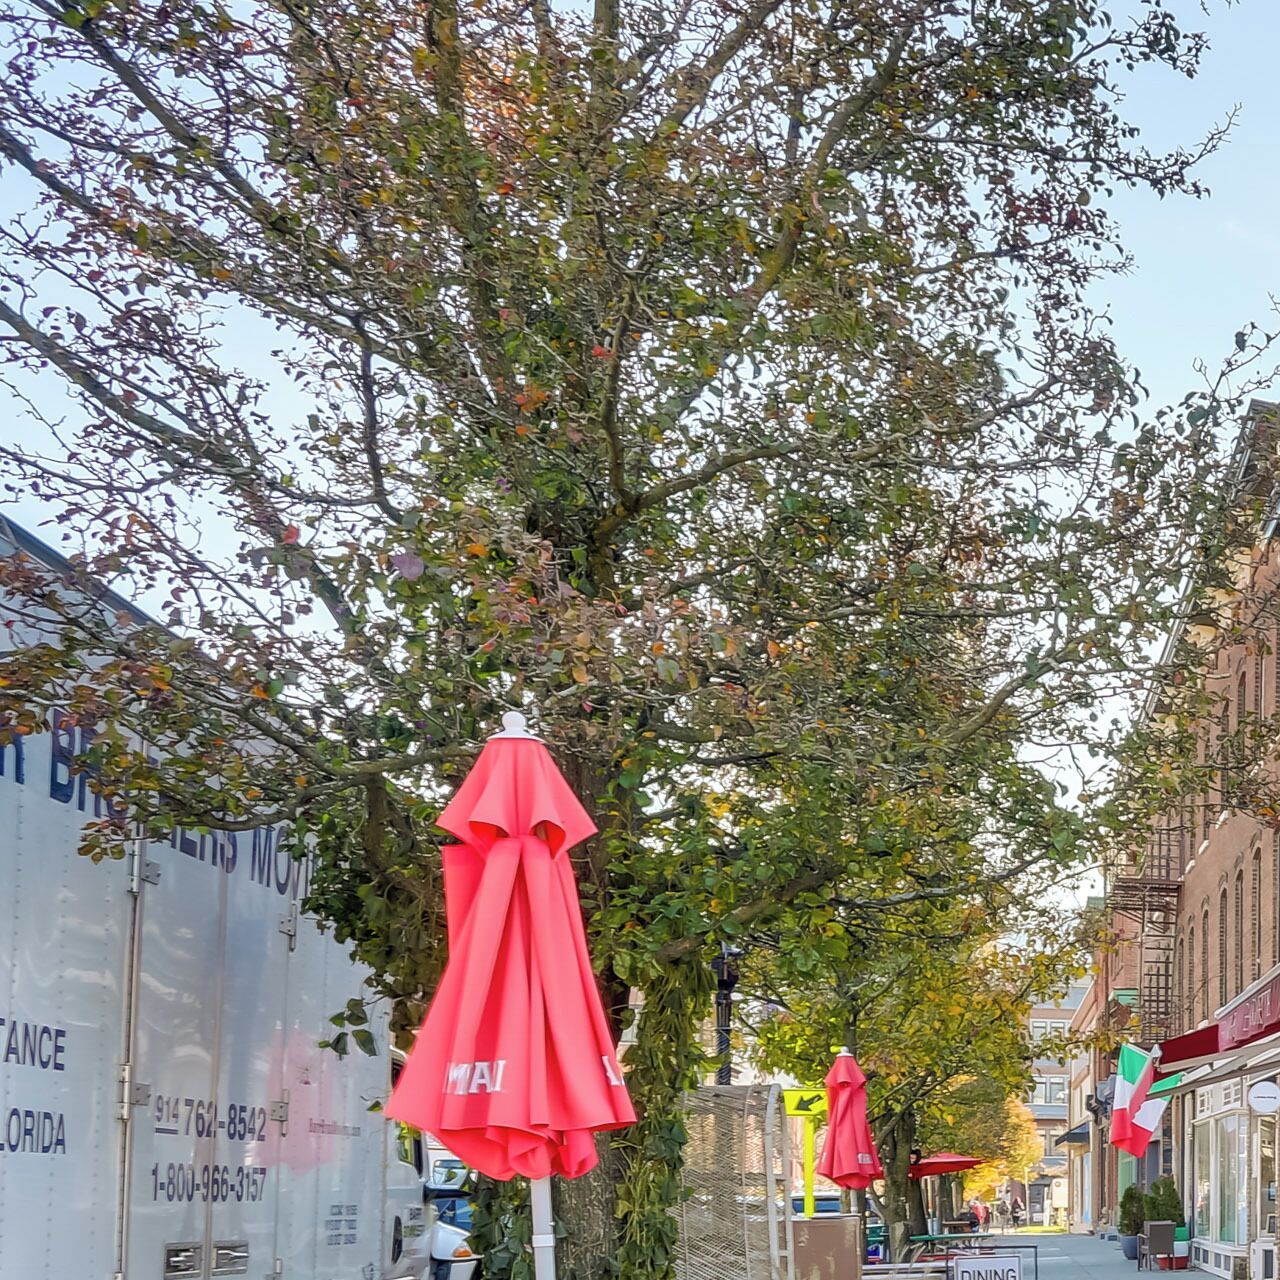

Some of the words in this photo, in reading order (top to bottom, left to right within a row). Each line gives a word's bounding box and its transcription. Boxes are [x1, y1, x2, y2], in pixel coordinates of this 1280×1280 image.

[0, 1018, 66, 1071] ANCE
[0, 1108, 67, 1154] ORIDA
[155, 1095, 180, 1124] 914
[184, 1098, 266, 1142] 762-8542
[152, 1163, 267, 1202] 1-800-966-3157
